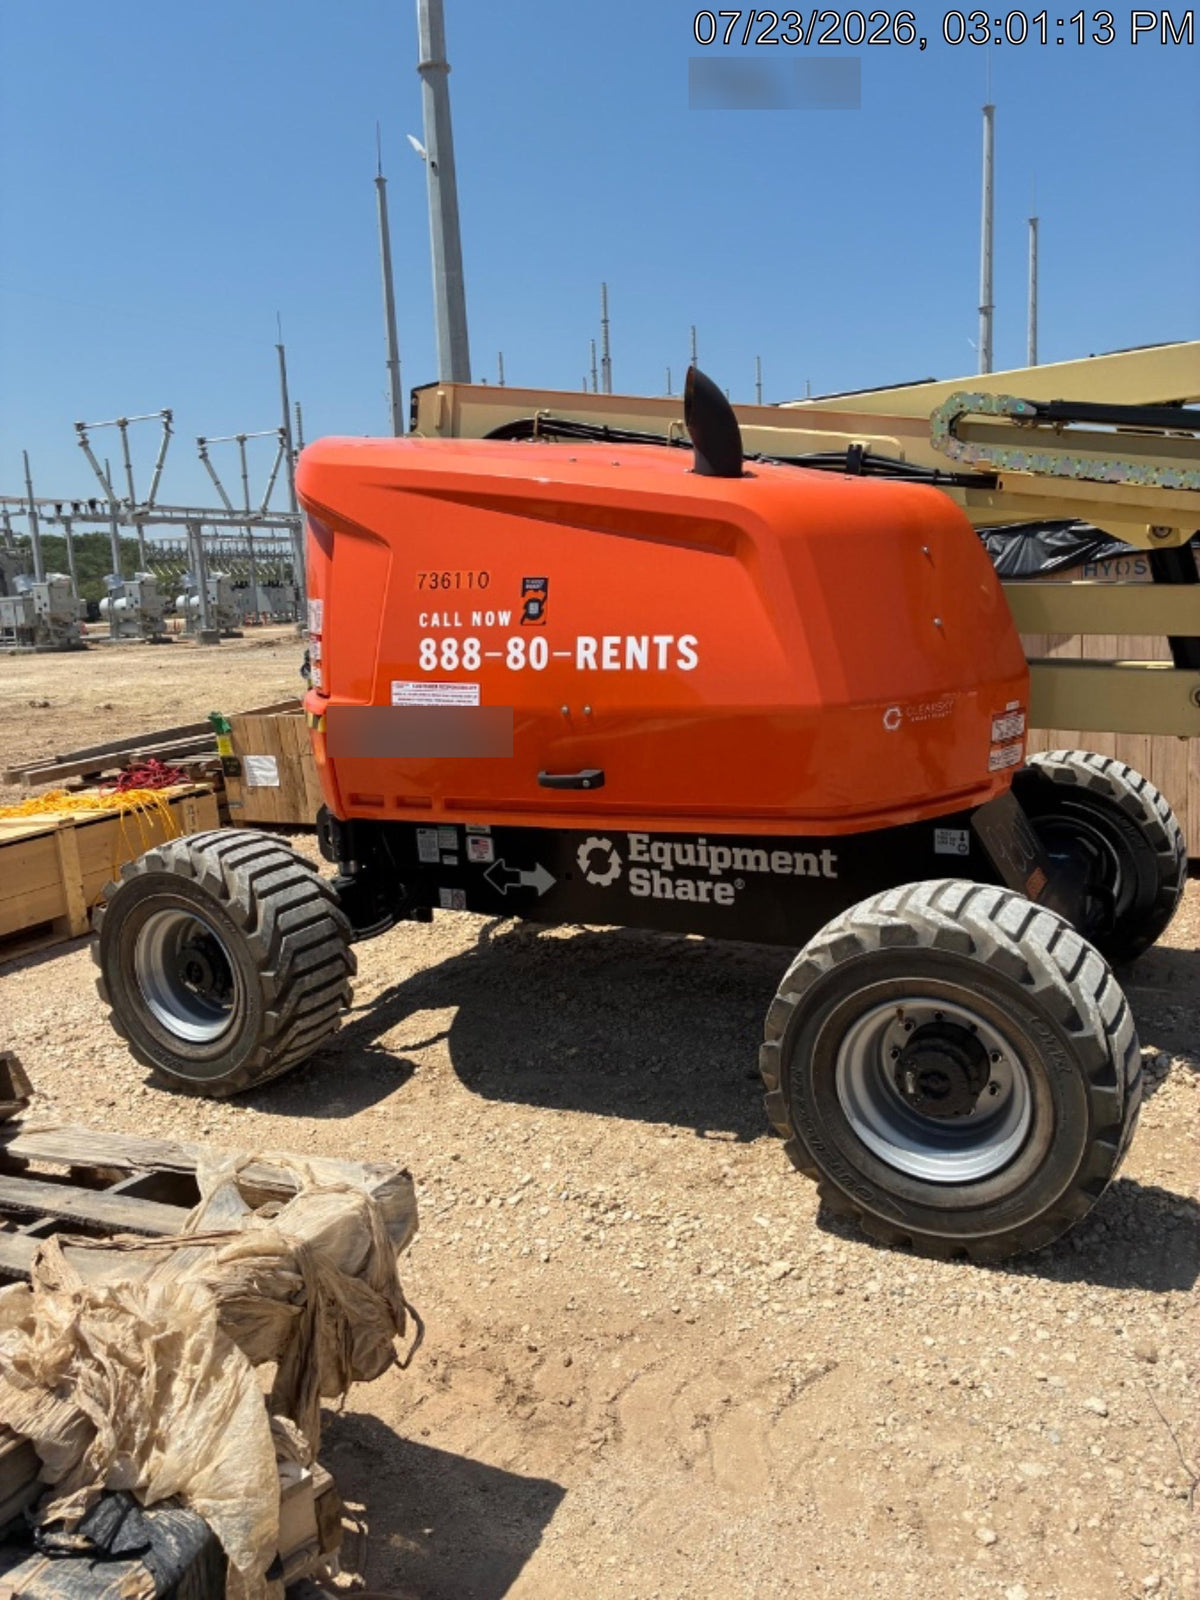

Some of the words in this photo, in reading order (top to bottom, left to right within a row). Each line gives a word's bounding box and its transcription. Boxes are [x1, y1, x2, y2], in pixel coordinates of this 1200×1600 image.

[417, 571, 490, 590] 736110
[419, 611, 463, 628] CALL
[471, 610, 512, 627] NOW
[418, 634, 700, 672] 888-80-RENTS
[627, 832, 839, 878] Equipment
